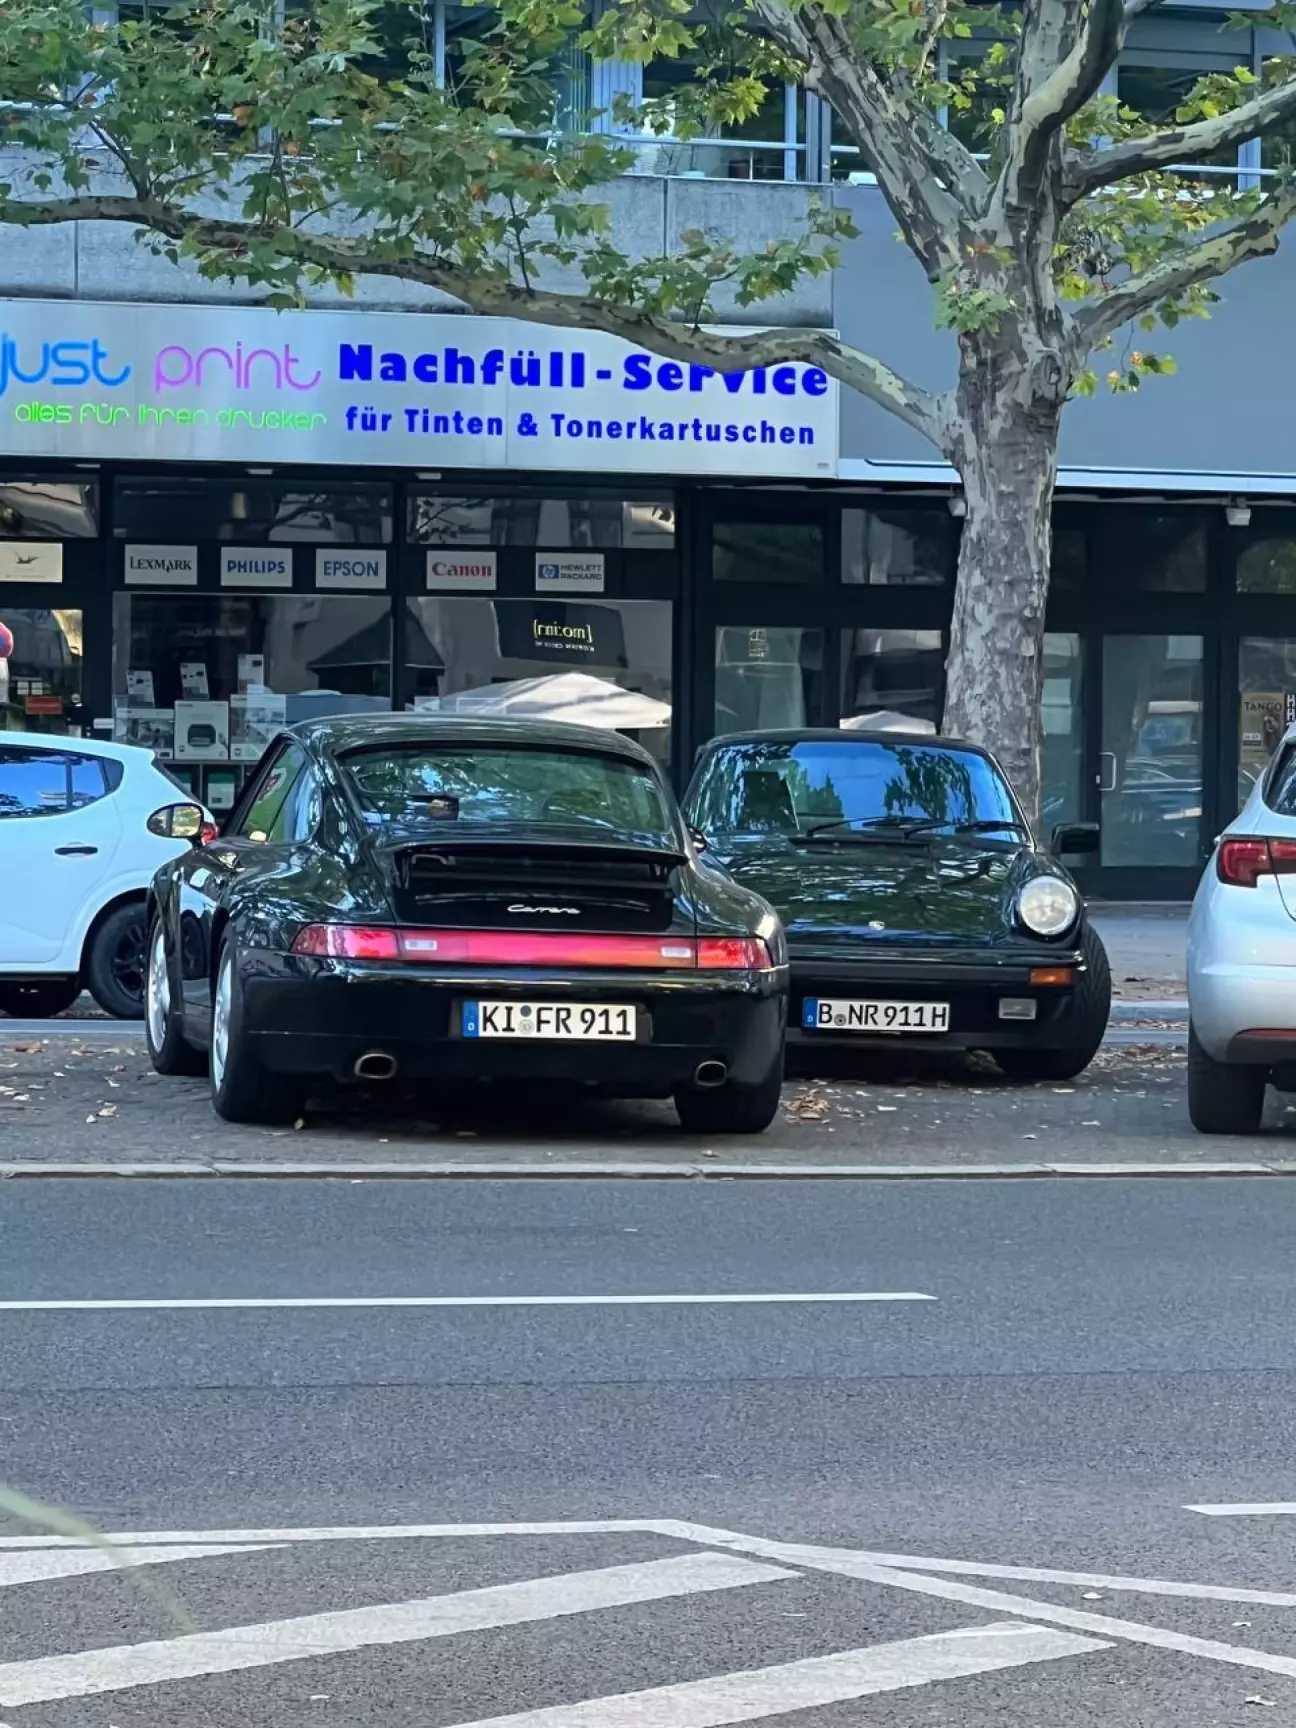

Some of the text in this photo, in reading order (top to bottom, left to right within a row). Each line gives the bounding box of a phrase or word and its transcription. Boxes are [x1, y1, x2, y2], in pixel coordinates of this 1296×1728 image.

[0, 331, 321, 396] just print
[15, 401, 73, 423] alles
[80, 403, 130, 426] für
[215, 407, 327, 431] drucker
[346, 406, 814, 445] für Tinten & Tonerkartuschen
[227, 560, 286, 574] PHILIPS
[323, 561, 379, 577] EPSON
[432, 562, 492, 577] Canon
[561, 564, 602, 572] HEWLETT
[1244, 701, 1282, 711] TANGO
[482, 1005, 631, 1036] KI FR 911
[849, 1004, 878, 1025] NR
